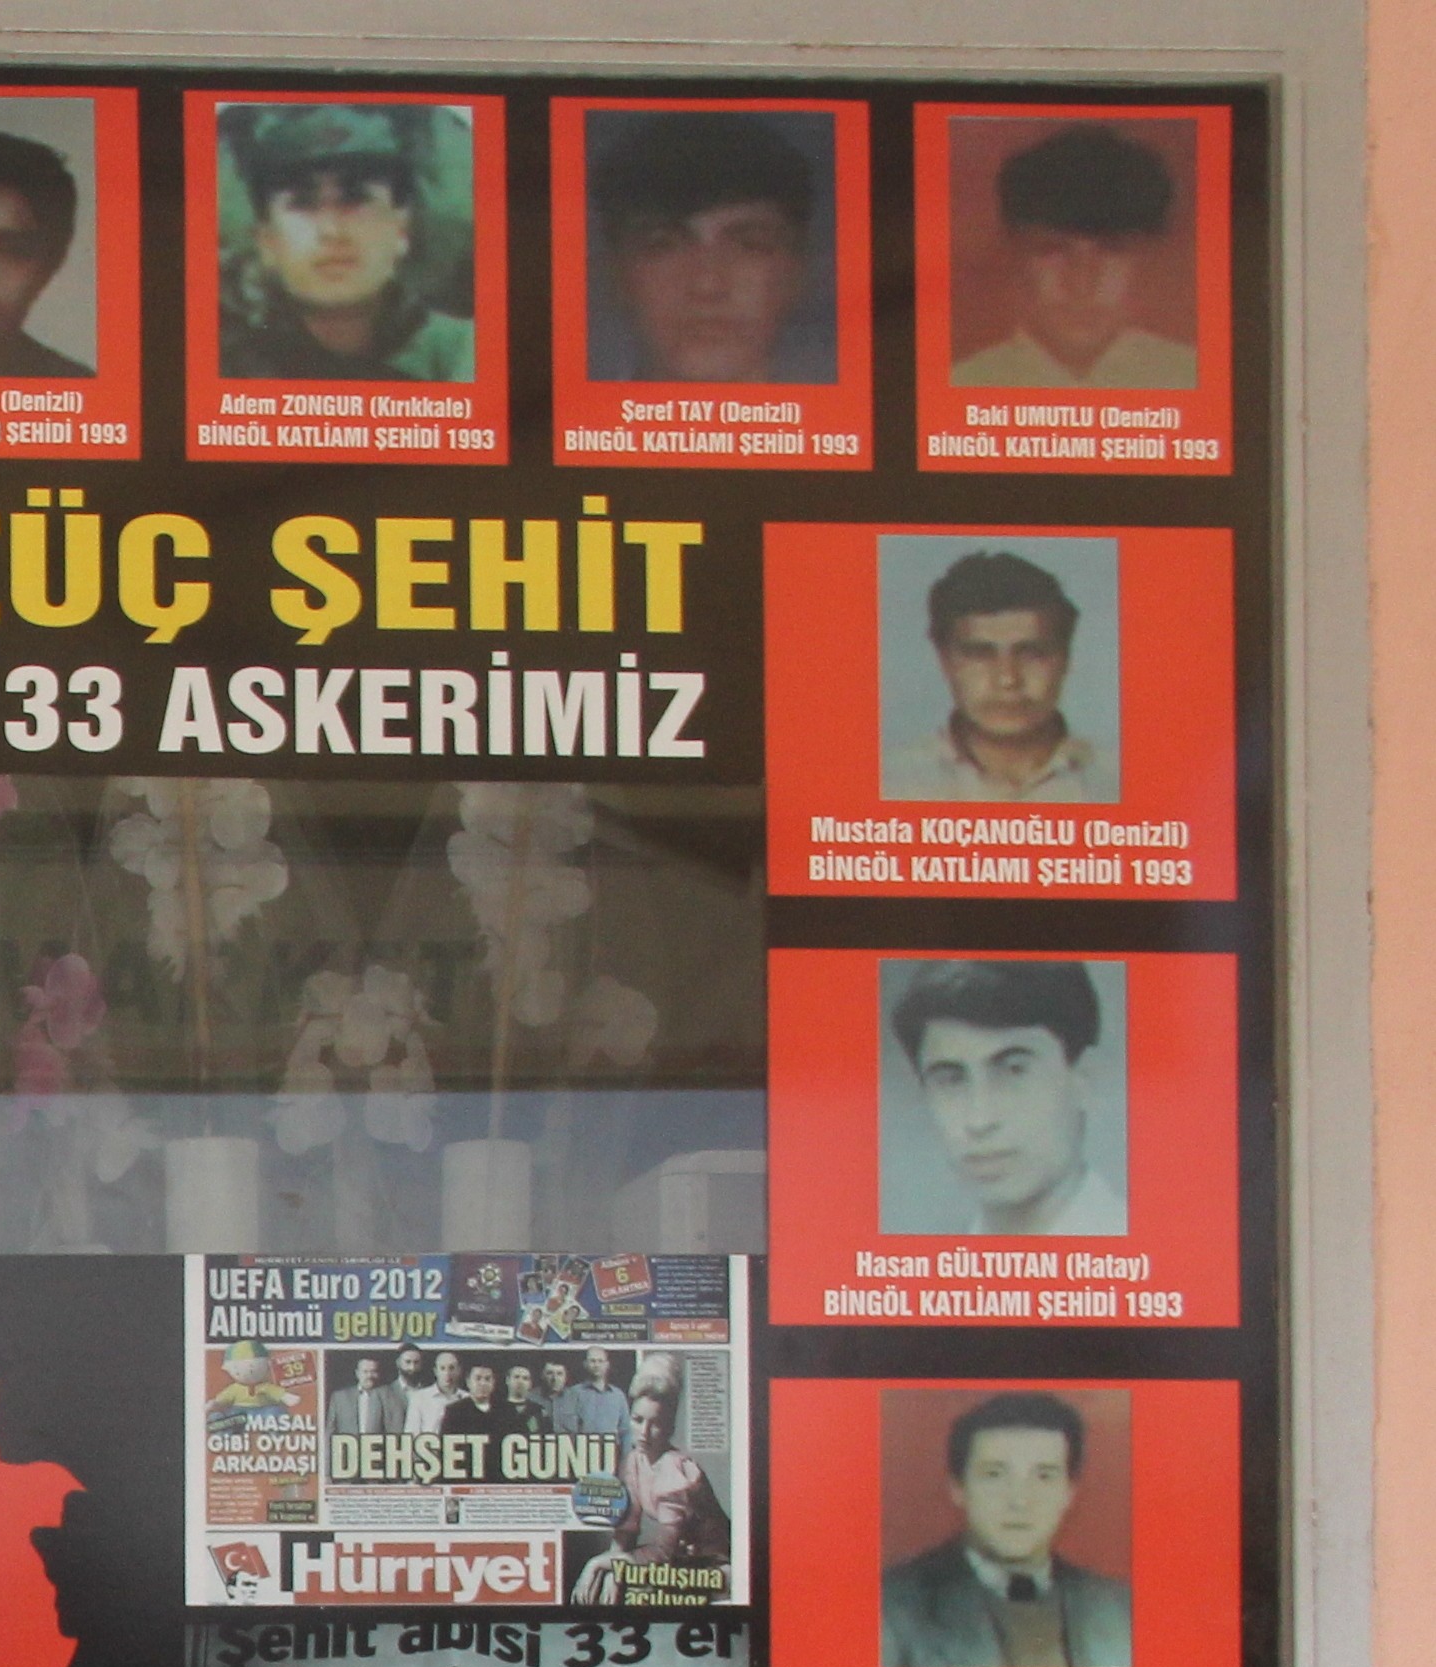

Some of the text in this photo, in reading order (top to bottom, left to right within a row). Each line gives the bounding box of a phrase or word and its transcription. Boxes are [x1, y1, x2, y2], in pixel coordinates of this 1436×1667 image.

[0, 389, 84, 414] (Denizli)
[219, 393, 472, 419] Adem ZONGUR (Kırıkkale)
[621, 399, 802, 424] Şeref TAY (Denizli)
[966, 404, 1181, 429] Baki UMUTLU (Denizli)
[270, 495, 703, 646] ŞEHİT
[4, 665, 123, 753] 33
[158, 651, 705, 758] ASKERİMİZ
[811, 814, 1191, 849] Mustafa KOÇANOĞLU (Denizli)
[855, 1245, 1152, 1283] Hasan GÜLTUTAN (Hatay)
[208, 1267, 443, 1300] UEFA Euro 2012
[208, 1303, 438, 1342] Albümü geliyor
[329, 1432, 618, 1484] DEHŞET GÜNÜ
